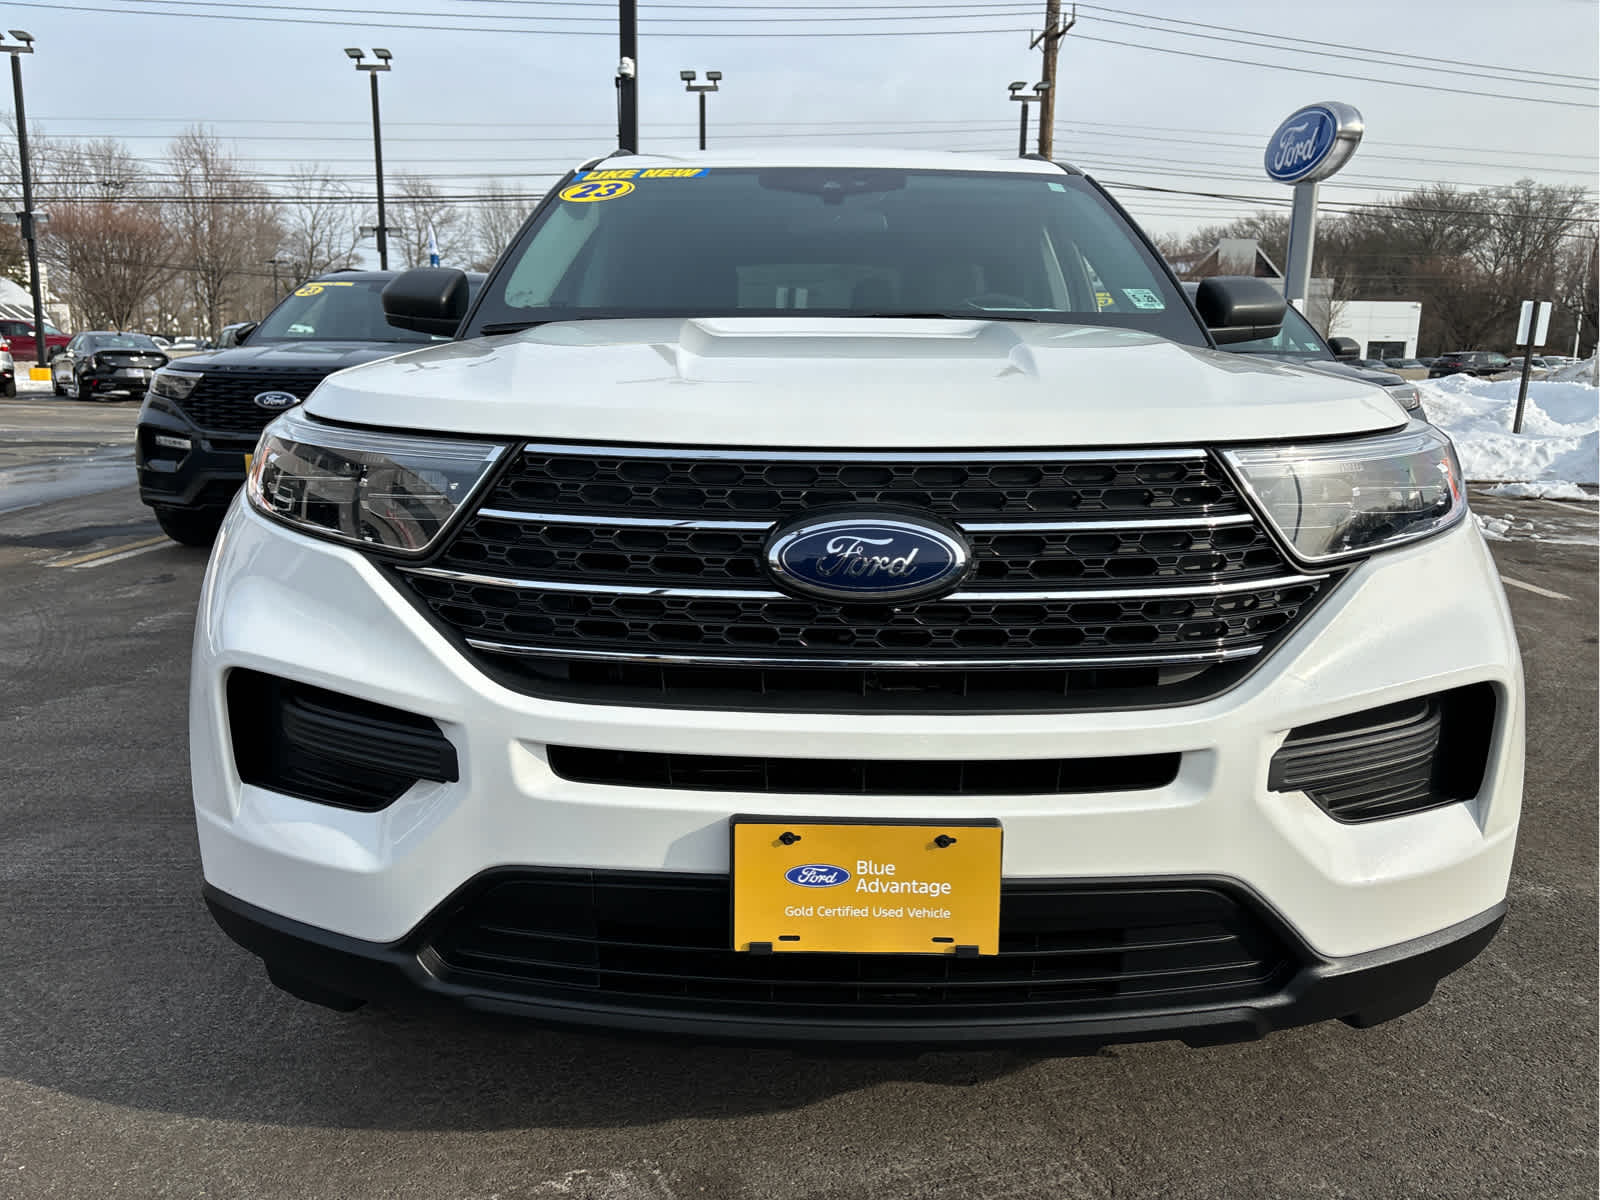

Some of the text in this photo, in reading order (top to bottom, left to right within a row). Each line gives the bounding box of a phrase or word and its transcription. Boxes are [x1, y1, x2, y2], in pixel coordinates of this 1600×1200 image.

[1274, 121, 1320, 170] Ford
[582, 168, 704, 181] LIKE NEW
[570, 183, 623, 198] 23
[263, 394, 288, 405] Ford
[816, 535, 920, 577] Ford
[798, 867, 839, 883] Ford
[856, 860, 896, 876] Blue
[856, 878, 952, 897] Advantage
[784, 905, 952, 919] Gold Certified Used Vehicle
